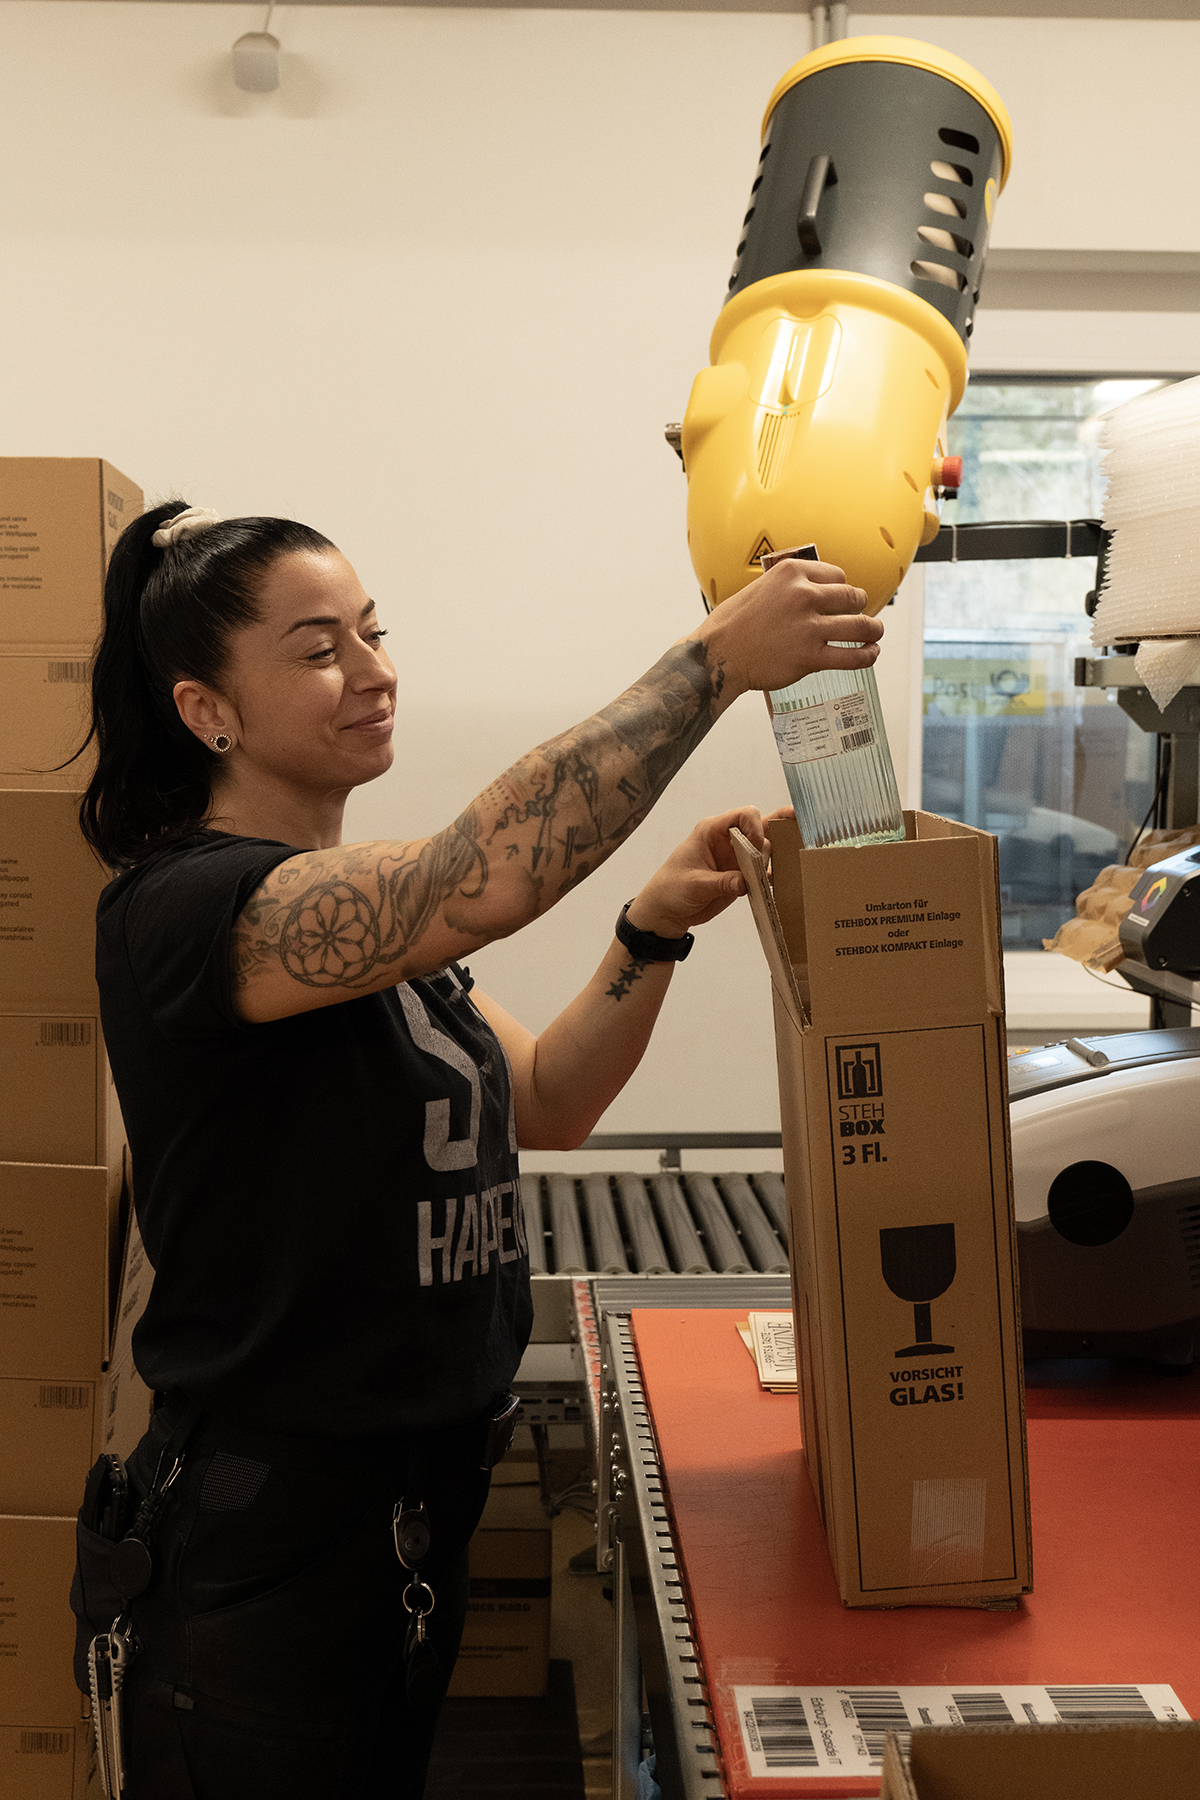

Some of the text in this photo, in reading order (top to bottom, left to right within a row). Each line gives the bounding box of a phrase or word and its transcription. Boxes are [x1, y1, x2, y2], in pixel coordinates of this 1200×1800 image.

[0, 874, 30, 883] ellpappe
[0, 900, 20, 908] gated
[865, 899, 929, 913] Umkarton für
[834, 911, 961, 929] STEHBOX PREMIUM Einlage
[888, 929, 910, 938] oder
[835, 938, 964, 957] STEHBOX KOMPAKT Einlage
[838, 1103, 885, 1121] STEH
[839, 1119, 886, 1138] BOX
[842, 1142, 888, 1165] 3 Fl.
[889, 1366, 964, 1383] VORSICHT
[889, 1382, 965, 1406] GLAS!
[810, 1697, 829, 1728] Edinburgh
[820, 1730, 838, 1757] Seaside
